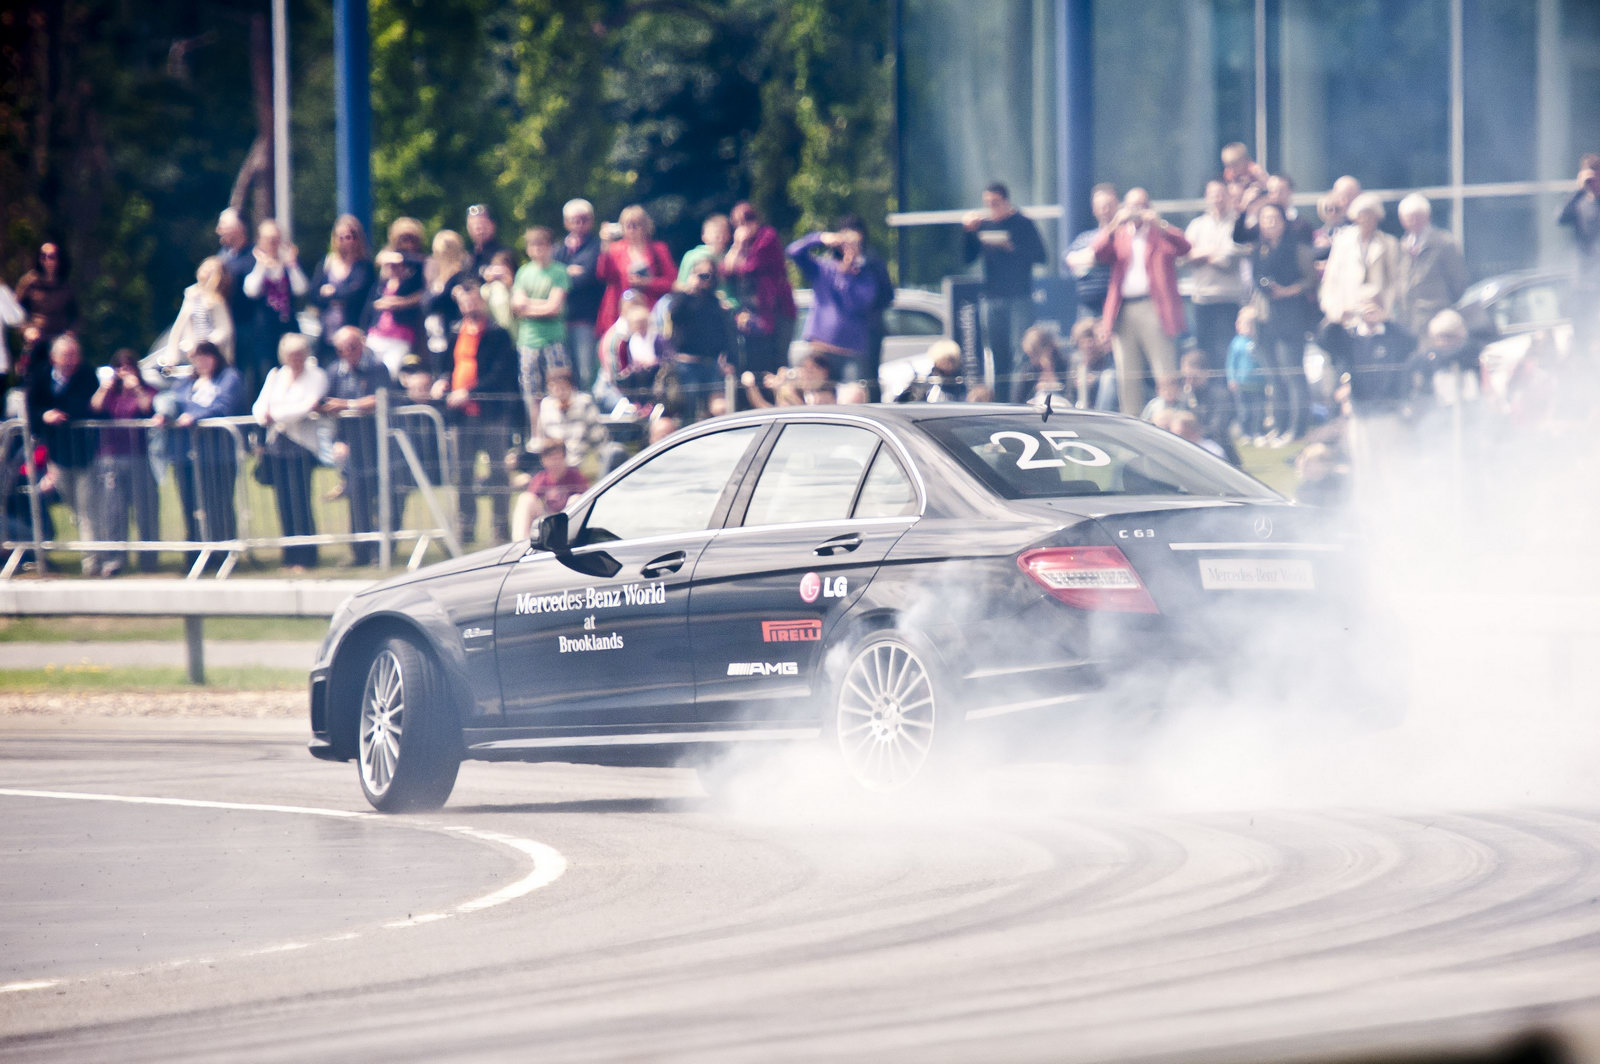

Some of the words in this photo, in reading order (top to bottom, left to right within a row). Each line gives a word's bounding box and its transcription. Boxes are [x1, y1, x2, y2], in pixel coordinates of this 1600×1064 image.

[989, 430, 1112, 470] 25
[1118, 529, 1129, 539] C
[1133, 529, 1155, 539] 63
[823, 576, 848, 598] LG
[515, 588, 621, 615] Mercedes-Benz
[622, 582, 666, 606] World
[584, 614, 596, 630] at
[761, 619, 822, 643] PIRELLI
[558, 632, 624, 653] Brooklands
[747, 662, 798, 676] AMG
